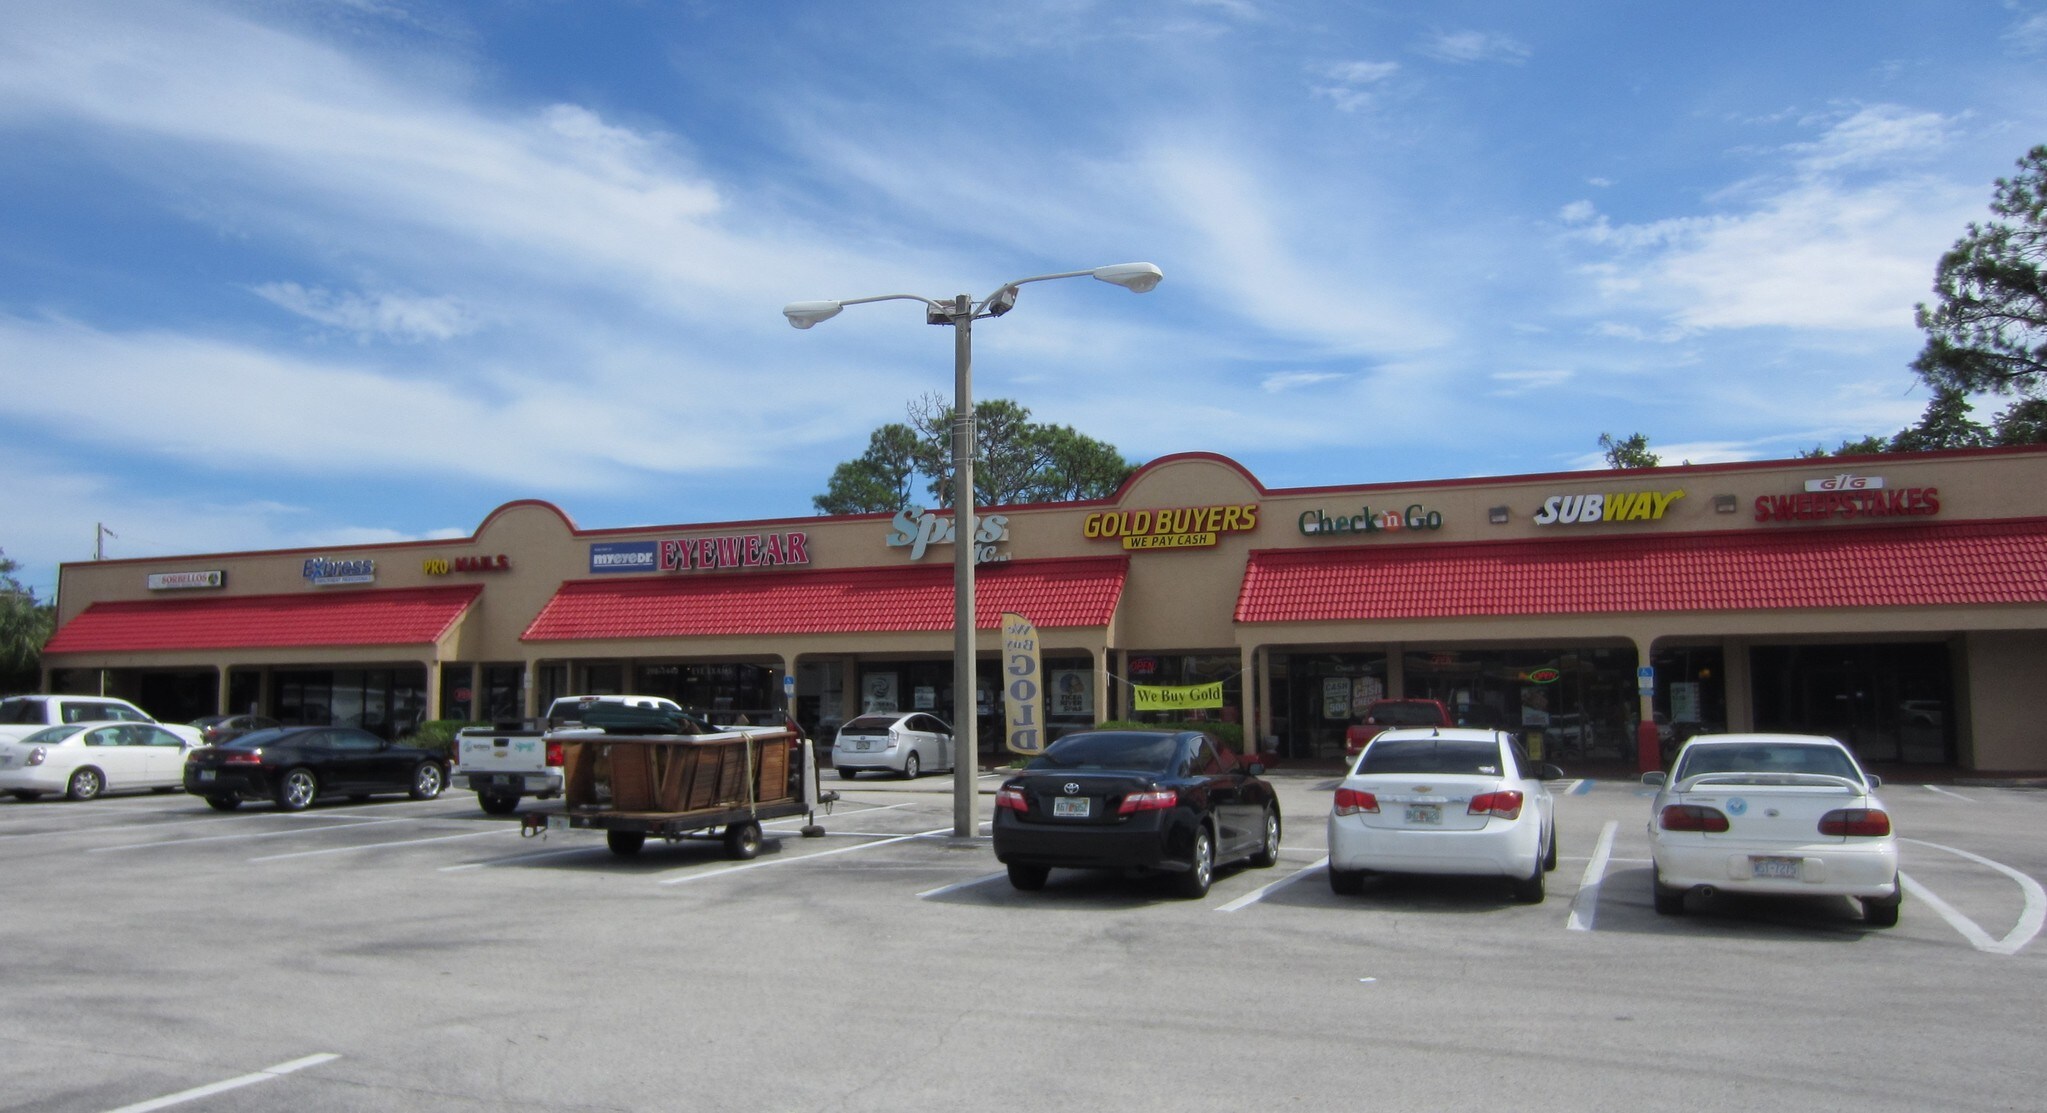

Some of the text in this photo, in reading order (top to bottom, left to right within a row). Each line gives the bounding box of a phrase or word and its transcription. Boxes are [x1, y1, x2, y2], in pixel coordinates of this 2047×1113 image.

[1083, 504, 1257, 538] GOLD BUYERS
[1298, 505, 1380, 536] Check
[1404, 504, 1442, 531] Go
[1533, 488, 1687, 526] SUBWAY
[1754, 487, 1940, 523] SWEEPSTAKES
[658, 532, 809, 571] EYEWEAR
[1130, 534, 1208, 547] WE PAY CASH
[423, 554, 511, 575] PRO NAILS
[1131, 660, 1155, 672] OPEN
[1137, 687, 1220, 705] We Buy Gold
